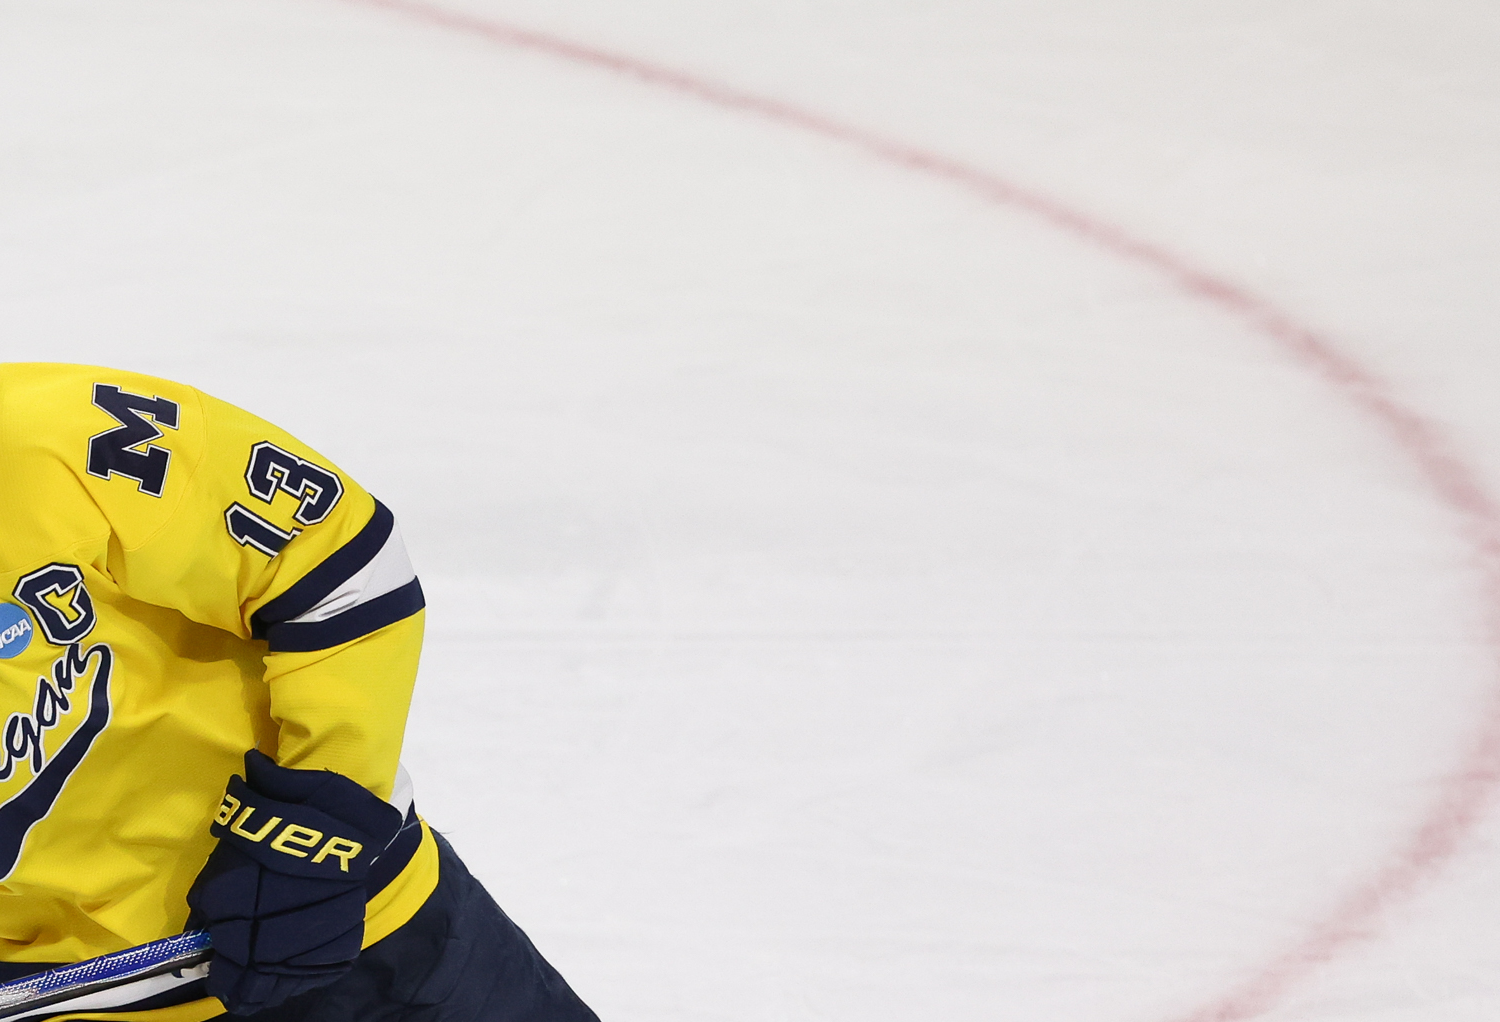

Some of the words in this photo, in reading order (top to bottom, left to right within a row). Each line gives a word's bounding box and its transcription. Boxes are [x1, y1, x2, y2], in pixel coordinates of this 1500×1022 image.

[86, 382, 180, 498] M
[224, 441, 344, 563] 13
[12, 562, 97, 645] C
[213, 793, 363, 873] AUER
